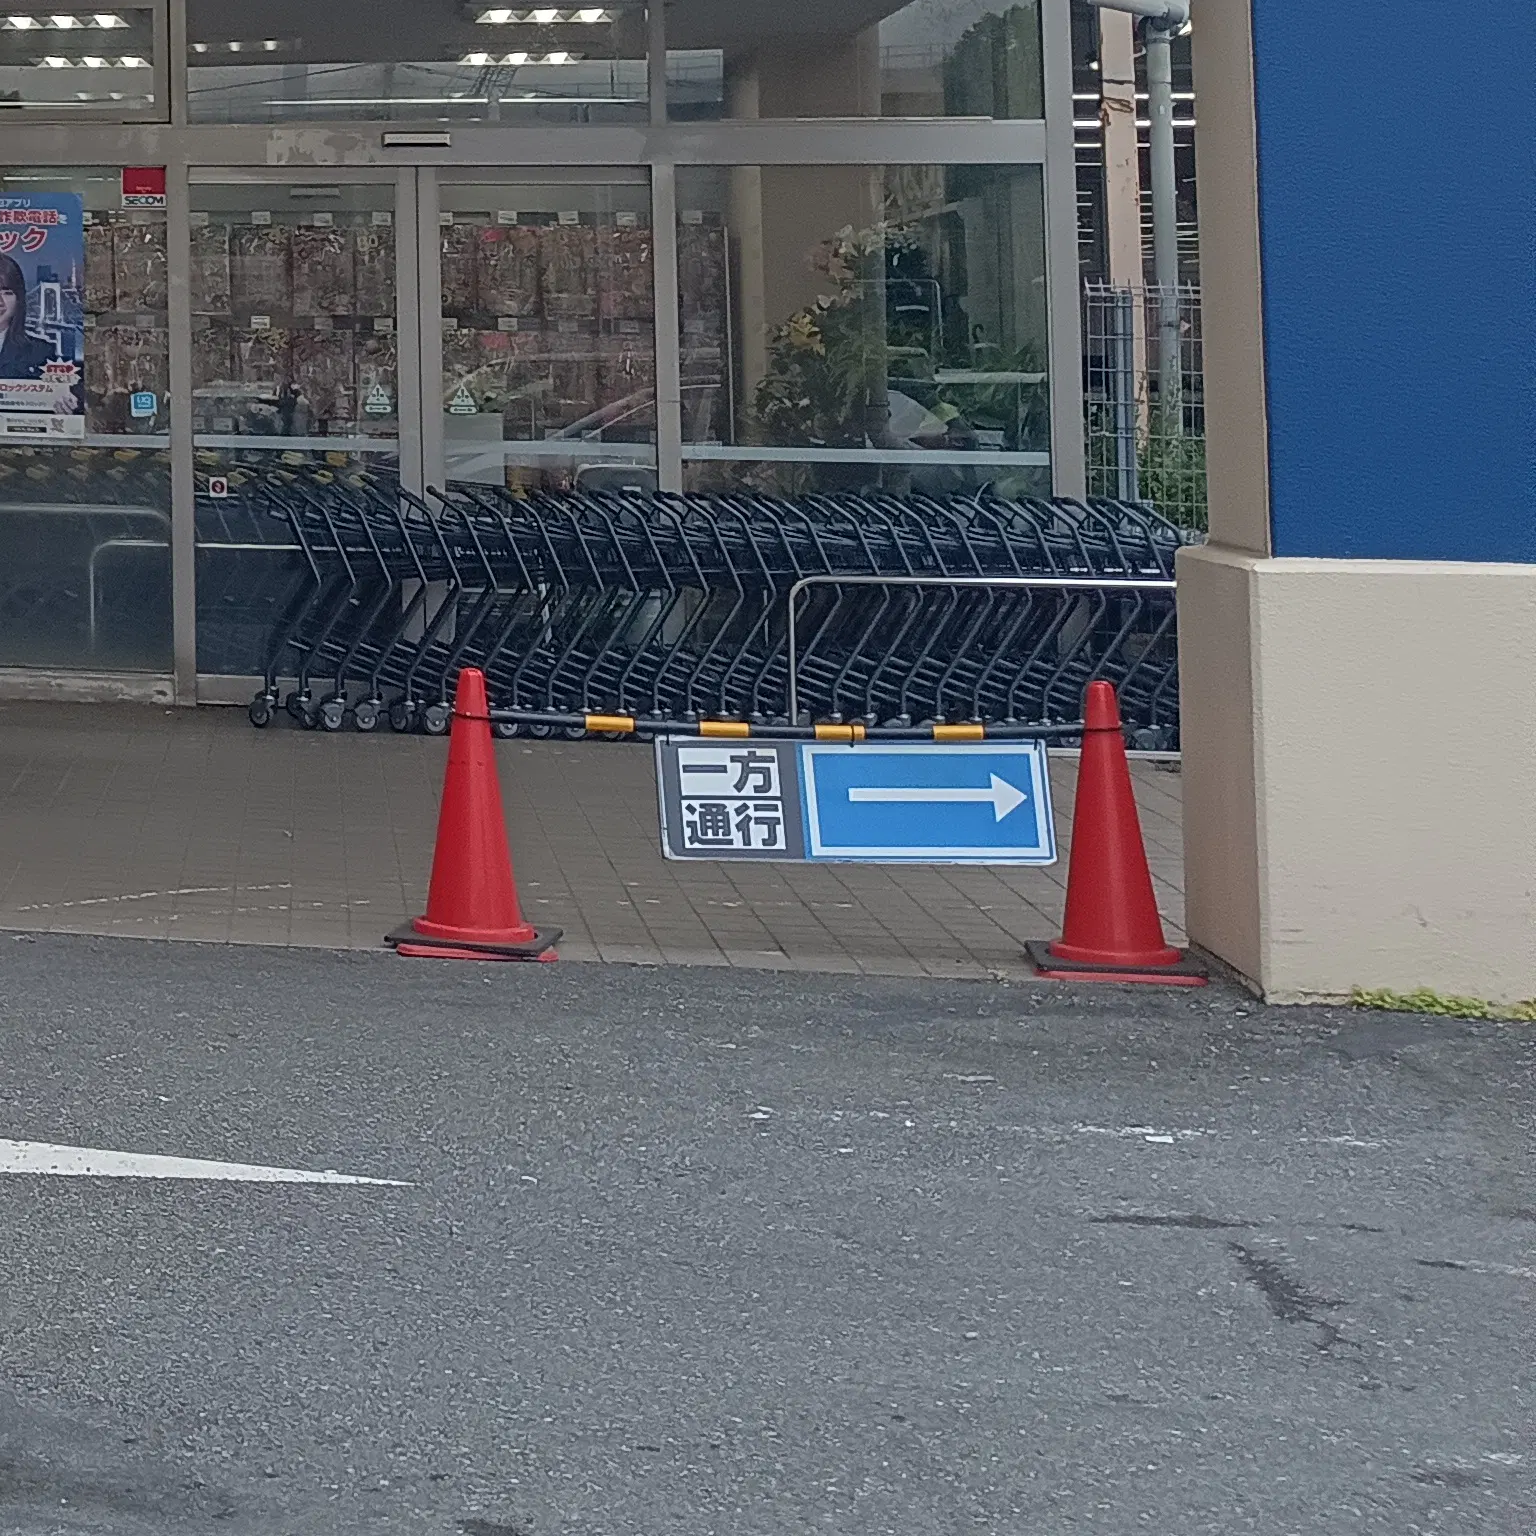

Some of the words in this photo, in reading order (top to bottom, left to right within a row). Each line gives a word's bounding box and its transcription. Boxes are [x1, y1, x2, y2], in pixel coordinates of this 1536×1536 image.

[123, 195, 165, 206] SECOM
[681, 750, 775, 794] 一方
[685, 802, 782, 848] 通行
